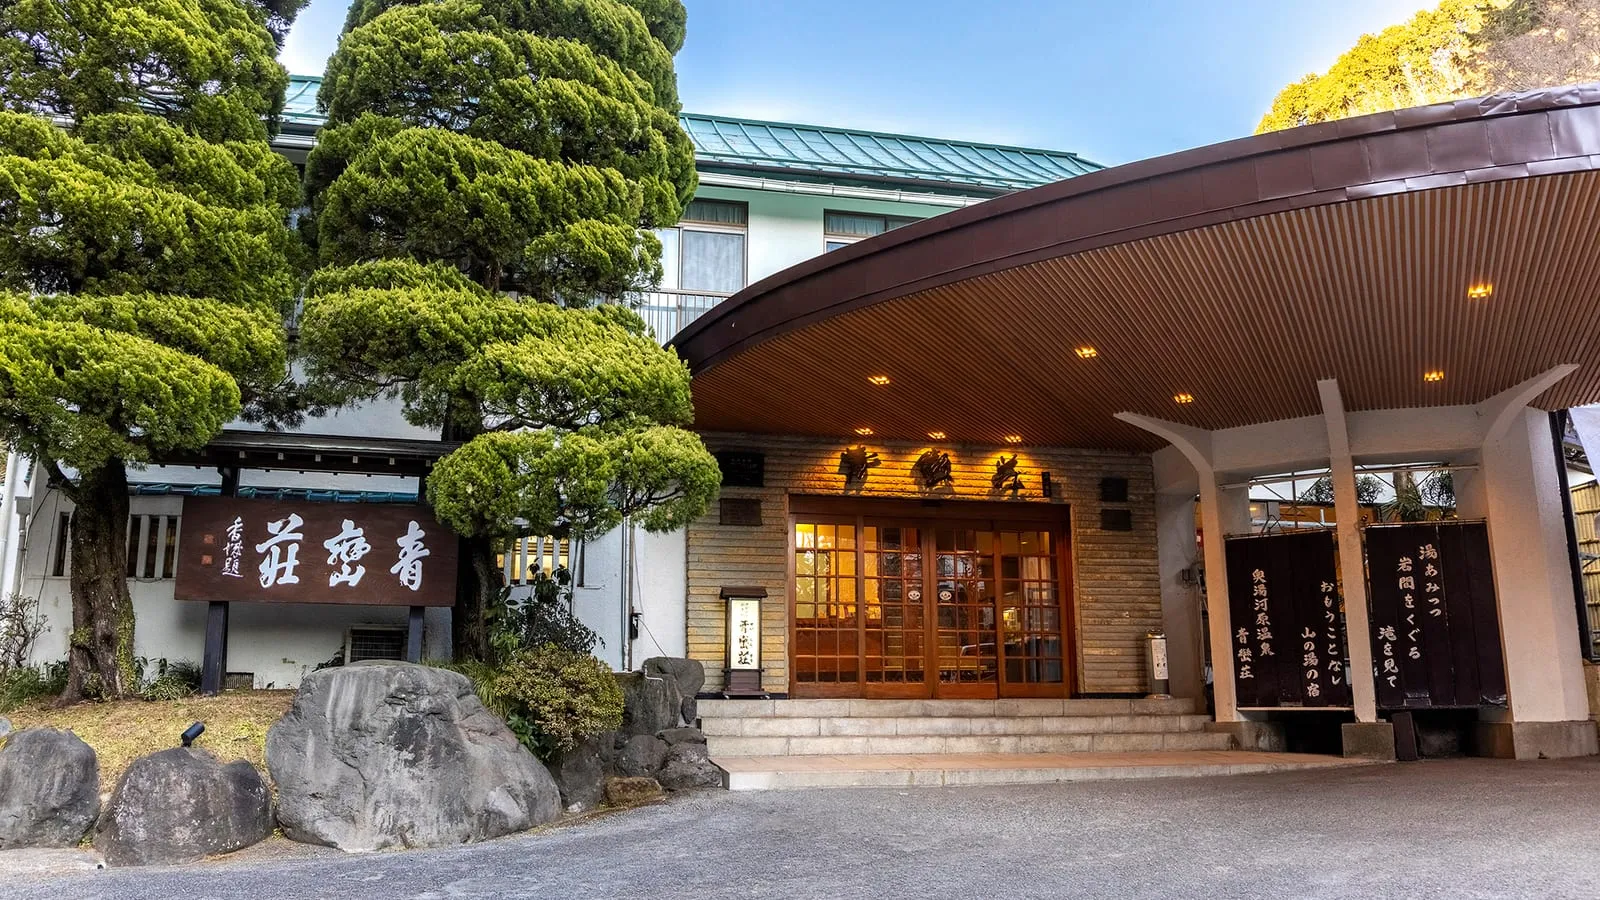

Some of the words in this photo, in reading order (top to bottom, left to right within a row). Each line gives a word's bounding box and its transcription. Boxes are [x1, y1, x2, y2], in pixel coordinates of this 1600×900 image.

[1252, 568, 1275, 657] 奥湯河原温泉
[1397, 556, 1421, 659] 岩間をくぐる
[1418, 543, 1442, 617] 湯あみつつ
[1301, 626, 1320, 698] 山の湯の宿
[1320, 581, 1342, 685] おもうことなし
[1377, 625, 1399, 688] 滝を見て
